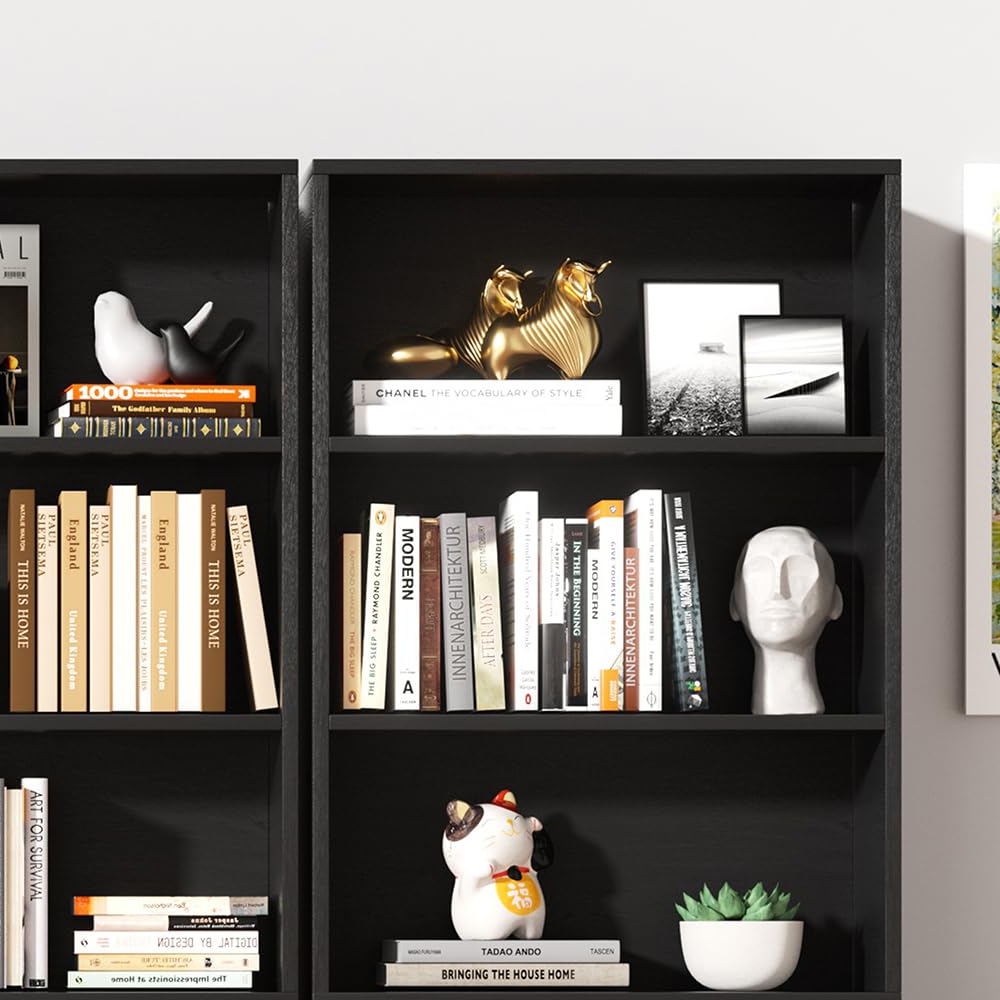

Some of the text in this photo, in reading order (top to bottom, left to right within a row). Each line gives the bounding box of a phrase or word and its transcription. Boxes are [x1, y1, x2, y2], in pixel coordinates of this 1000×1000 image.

[78, 385, 133, 400] 1000
[112, 405, 216, 414] The Godfather Family Album
[375, 389, 426, 398] CHANEL
[430, 389, 451, 398] THE
[454, 389, 527, 398] VOCABULARY
[531, 389, 545, 398] OF
[549, 389, 582, 398] STYLE
[37, 513, 46, 577] SIETSEMA
[47, 514, 56, 547] PAUL
[17, 560, 29, 591] THIS
[401, 528, 414, 600] MODERN
[17, 594, 29, 606] IS
[66, 519, 80, 691] England United Kingdom
[445, 525, 467, 681] INNENARCHITEKTUR
[477, 524, 497, 667] AFTER DAYS SCOTT MEDBURY
[17, 609, 29, 649] HOME
[367, 532, 383, 696] THE BIG SLEEP RAYMOND CHANDLER
[625, 558, 636, 687] INNENARCHITEKTUR
[481, 947, 542, 956] TADAO ANDO
[441, 969, 576, 980] BRINGING THE HOUSE HOME
